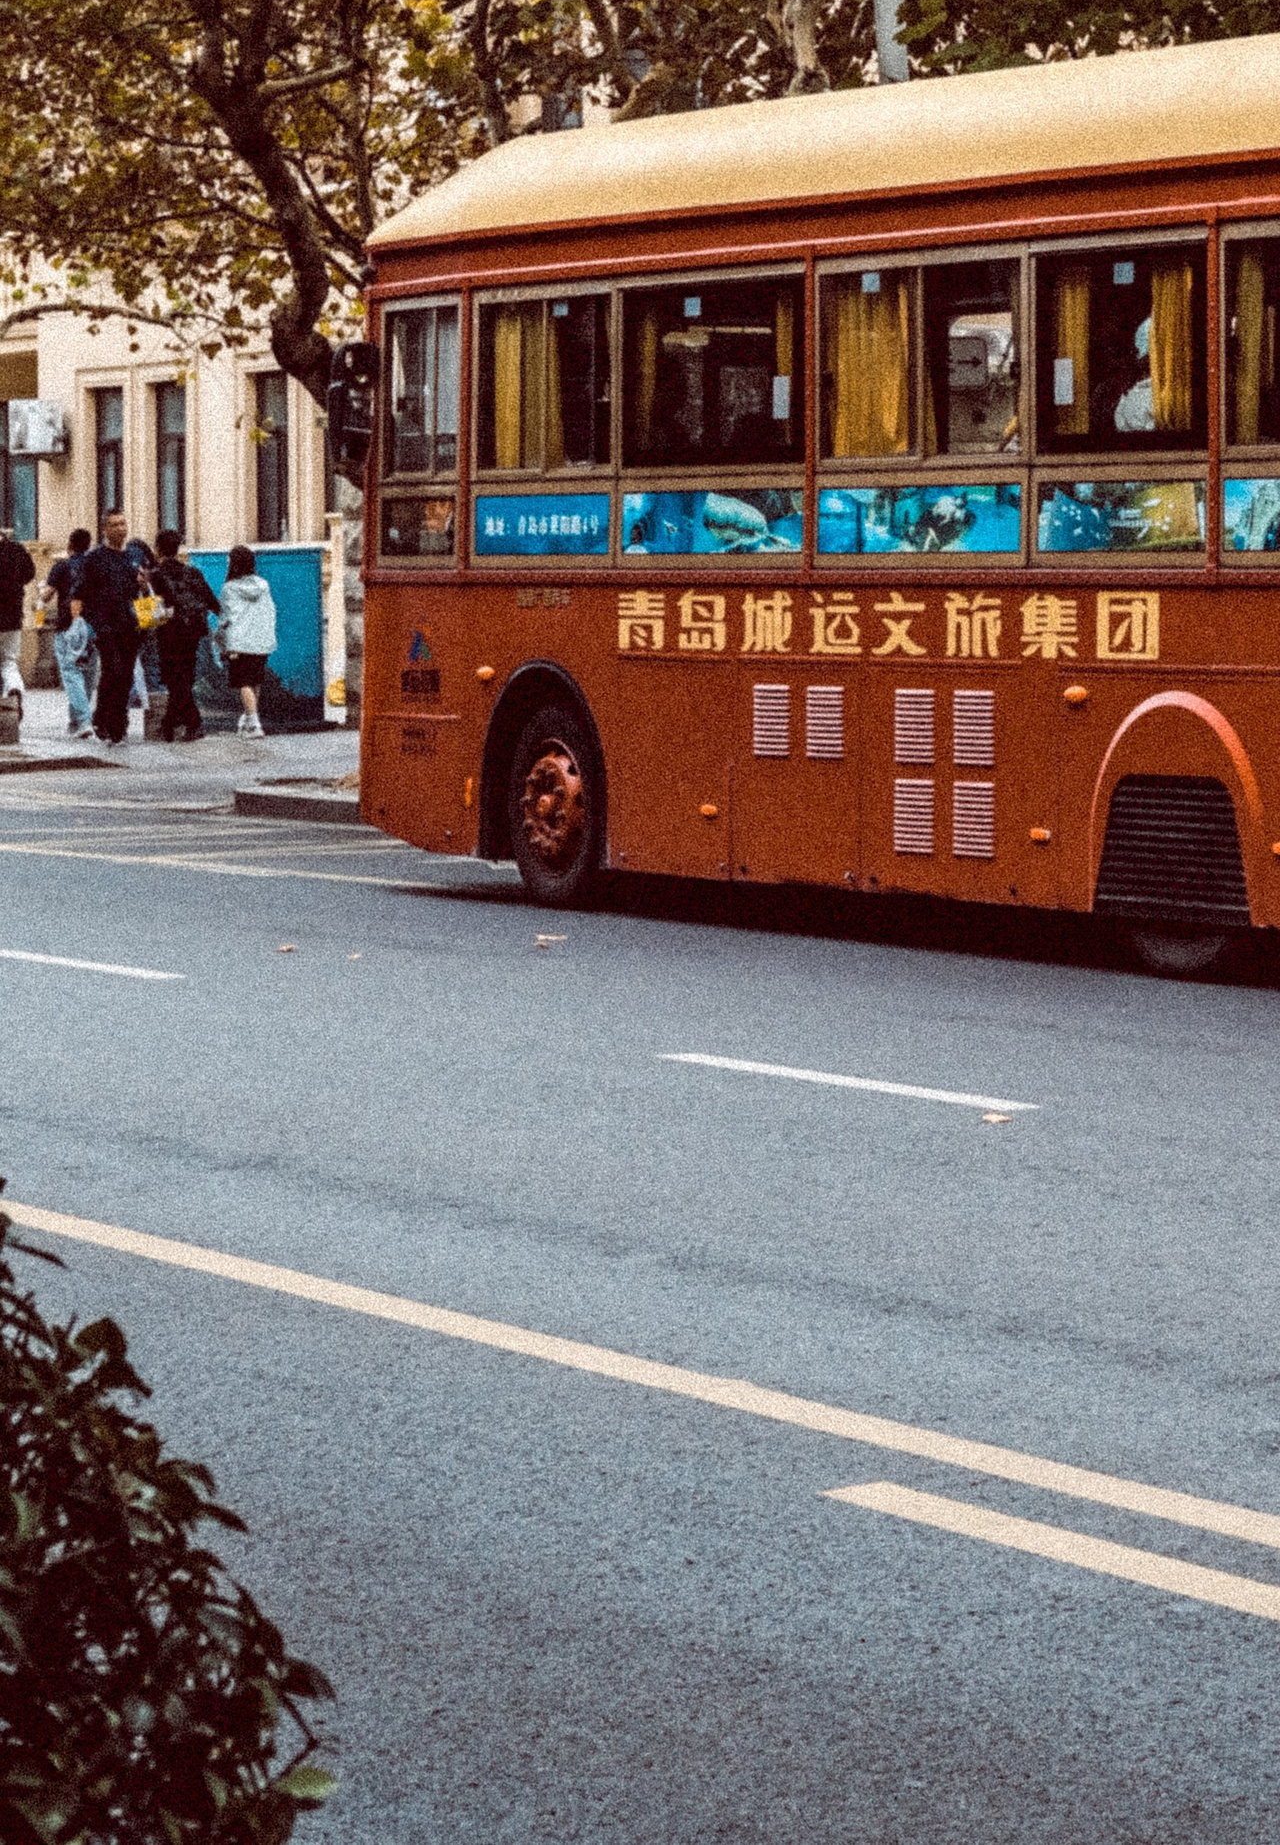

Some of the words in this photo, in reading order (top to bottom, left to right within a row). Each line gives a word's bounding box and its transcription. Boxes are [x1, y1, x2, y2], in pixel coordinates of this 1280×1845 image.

[617, 589, 1160, 660] 青岛城运文旅集团
